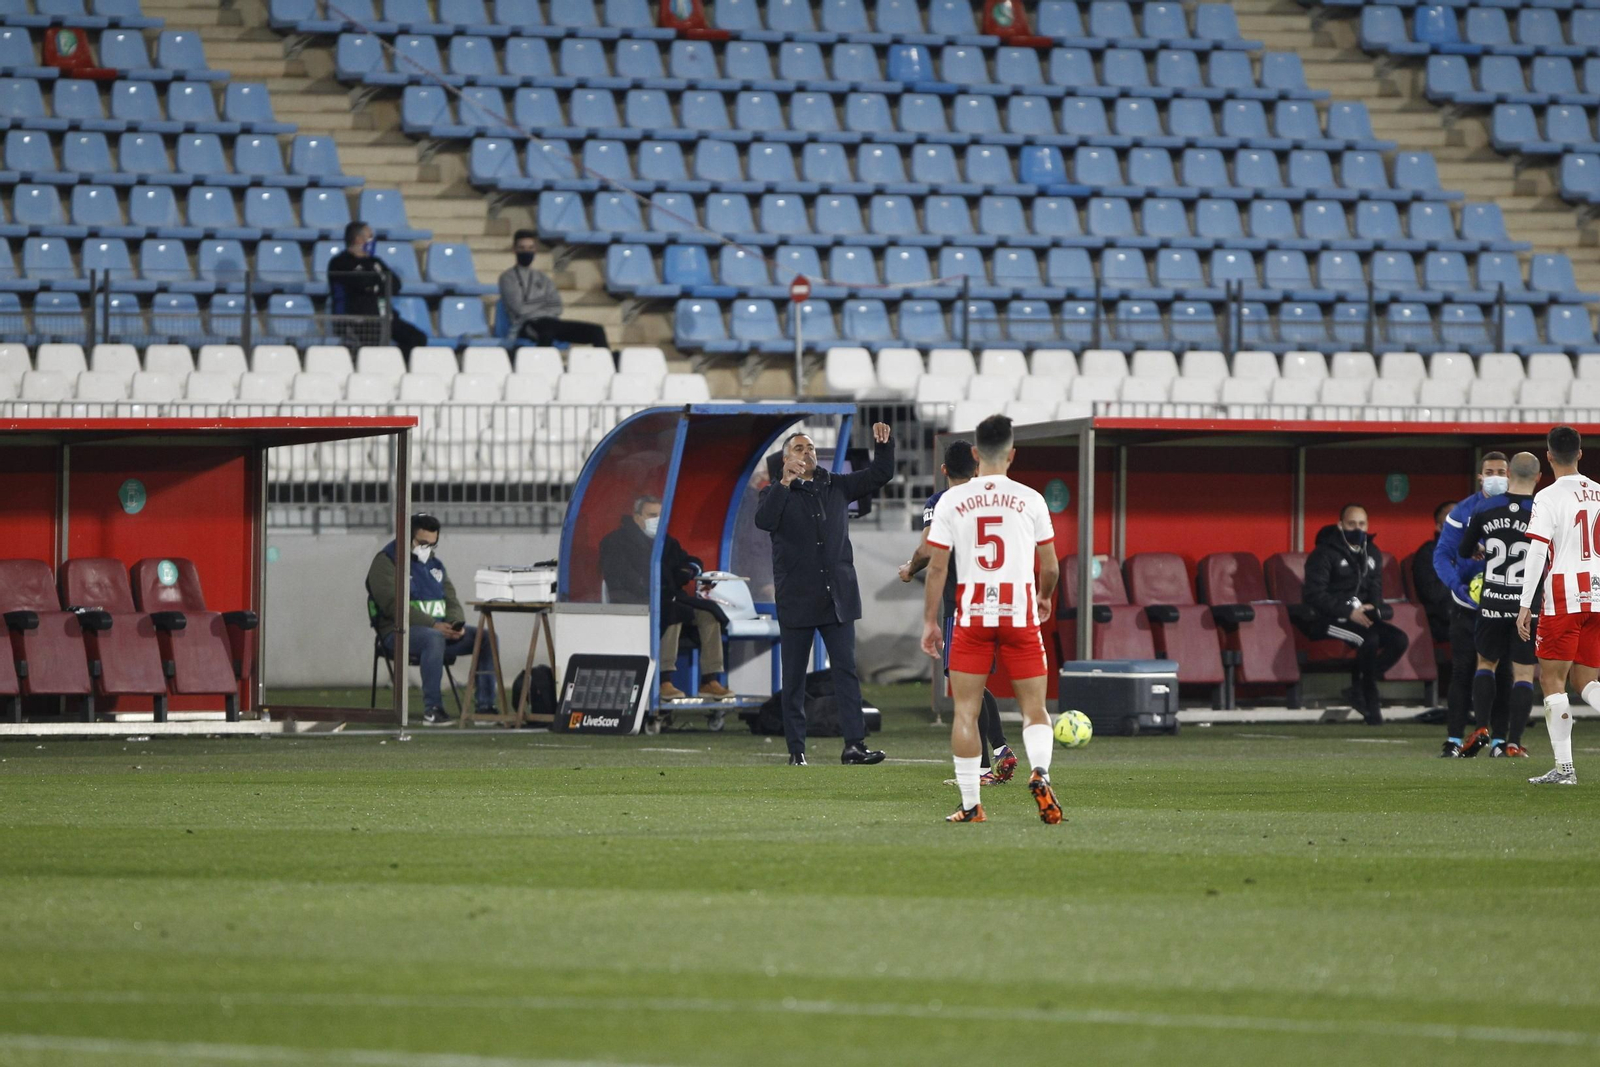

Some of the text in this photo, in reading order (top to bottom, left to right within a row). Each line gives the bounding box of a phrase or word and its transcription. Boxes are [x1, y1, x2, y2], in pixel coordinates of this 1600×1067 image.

[955, 494, 1026, 518] MORLANES
[1483, 518, 1511, 535] PARIS
[975, 516, 1005, 572] 5
[1485, 537, 1531, 587] 22
[582, 715, 620, 728] LiveScore
